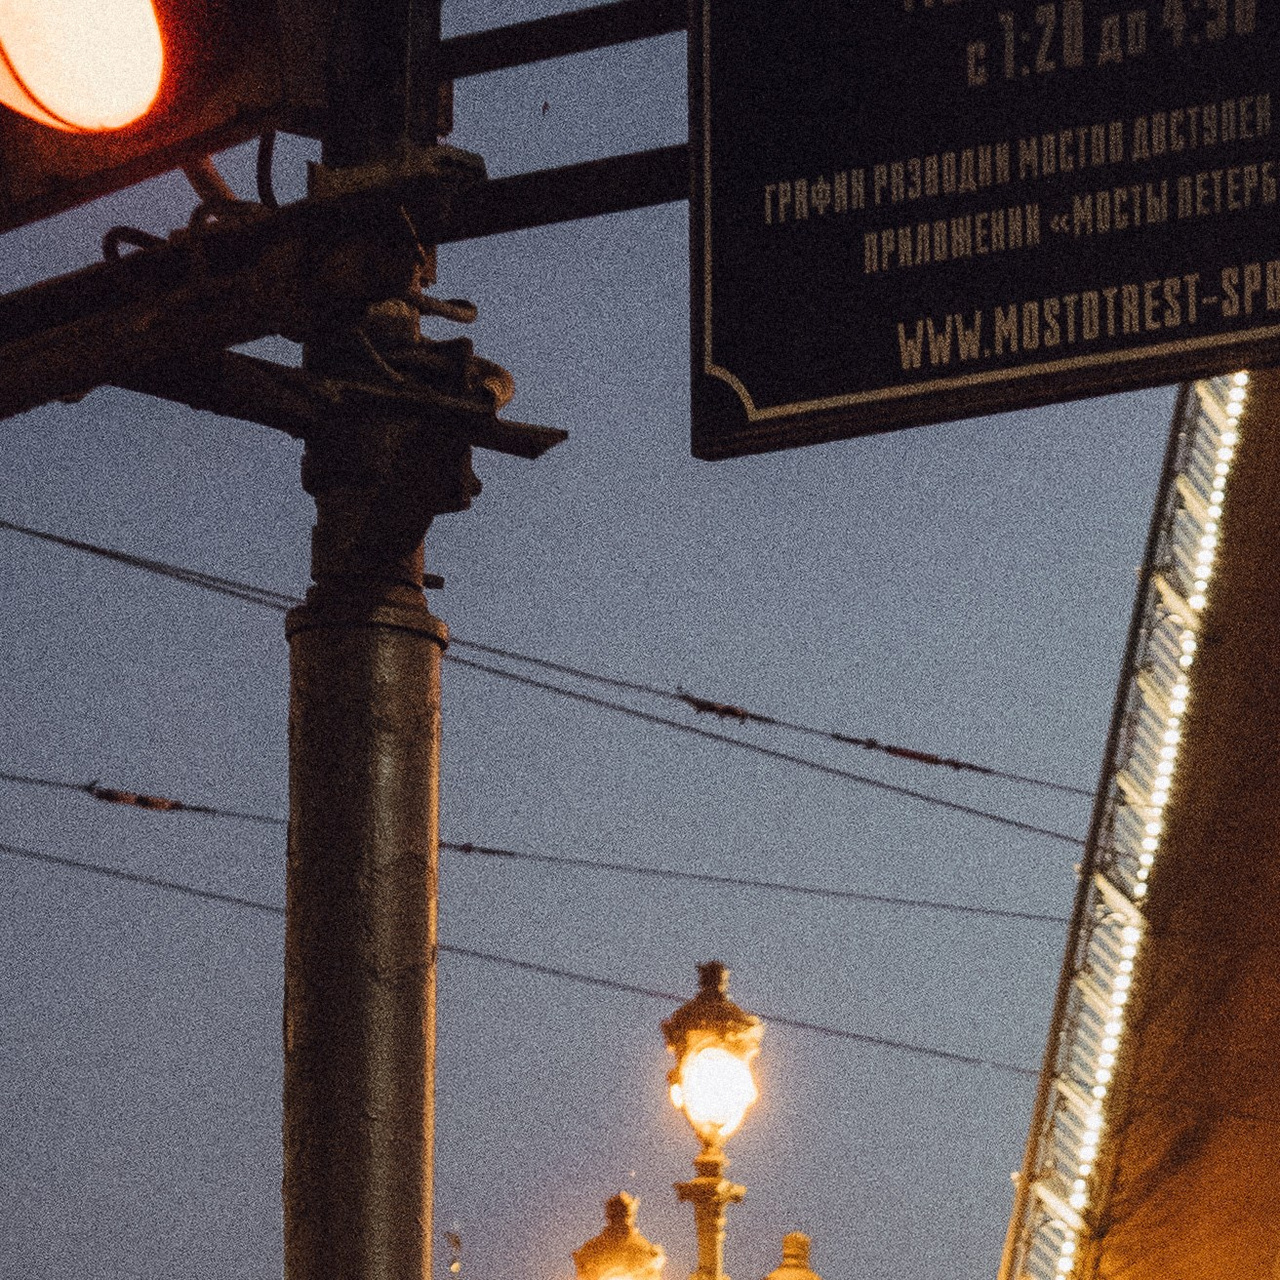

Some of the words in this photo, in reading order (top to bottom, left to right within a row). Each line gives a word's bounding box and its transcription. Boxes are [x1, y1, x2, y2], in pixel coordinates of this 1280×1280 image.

[998, 0, 1084, 79] 1:20
[1097, 10, 1148, 67] до
[764, 168, 865, 225] ГРАФИК
[874, 142, 1011, 205] РАЗВОДКИ
[1019, 120, 1125, 180] МОСТОВ
[1132, 92, 1272, 162] ДОСТУПЕН
[863, 203, 1042, 275] ПРИЛОЖЕНИИ
[1050, 179, 1169, 238] «МОСТЫ
